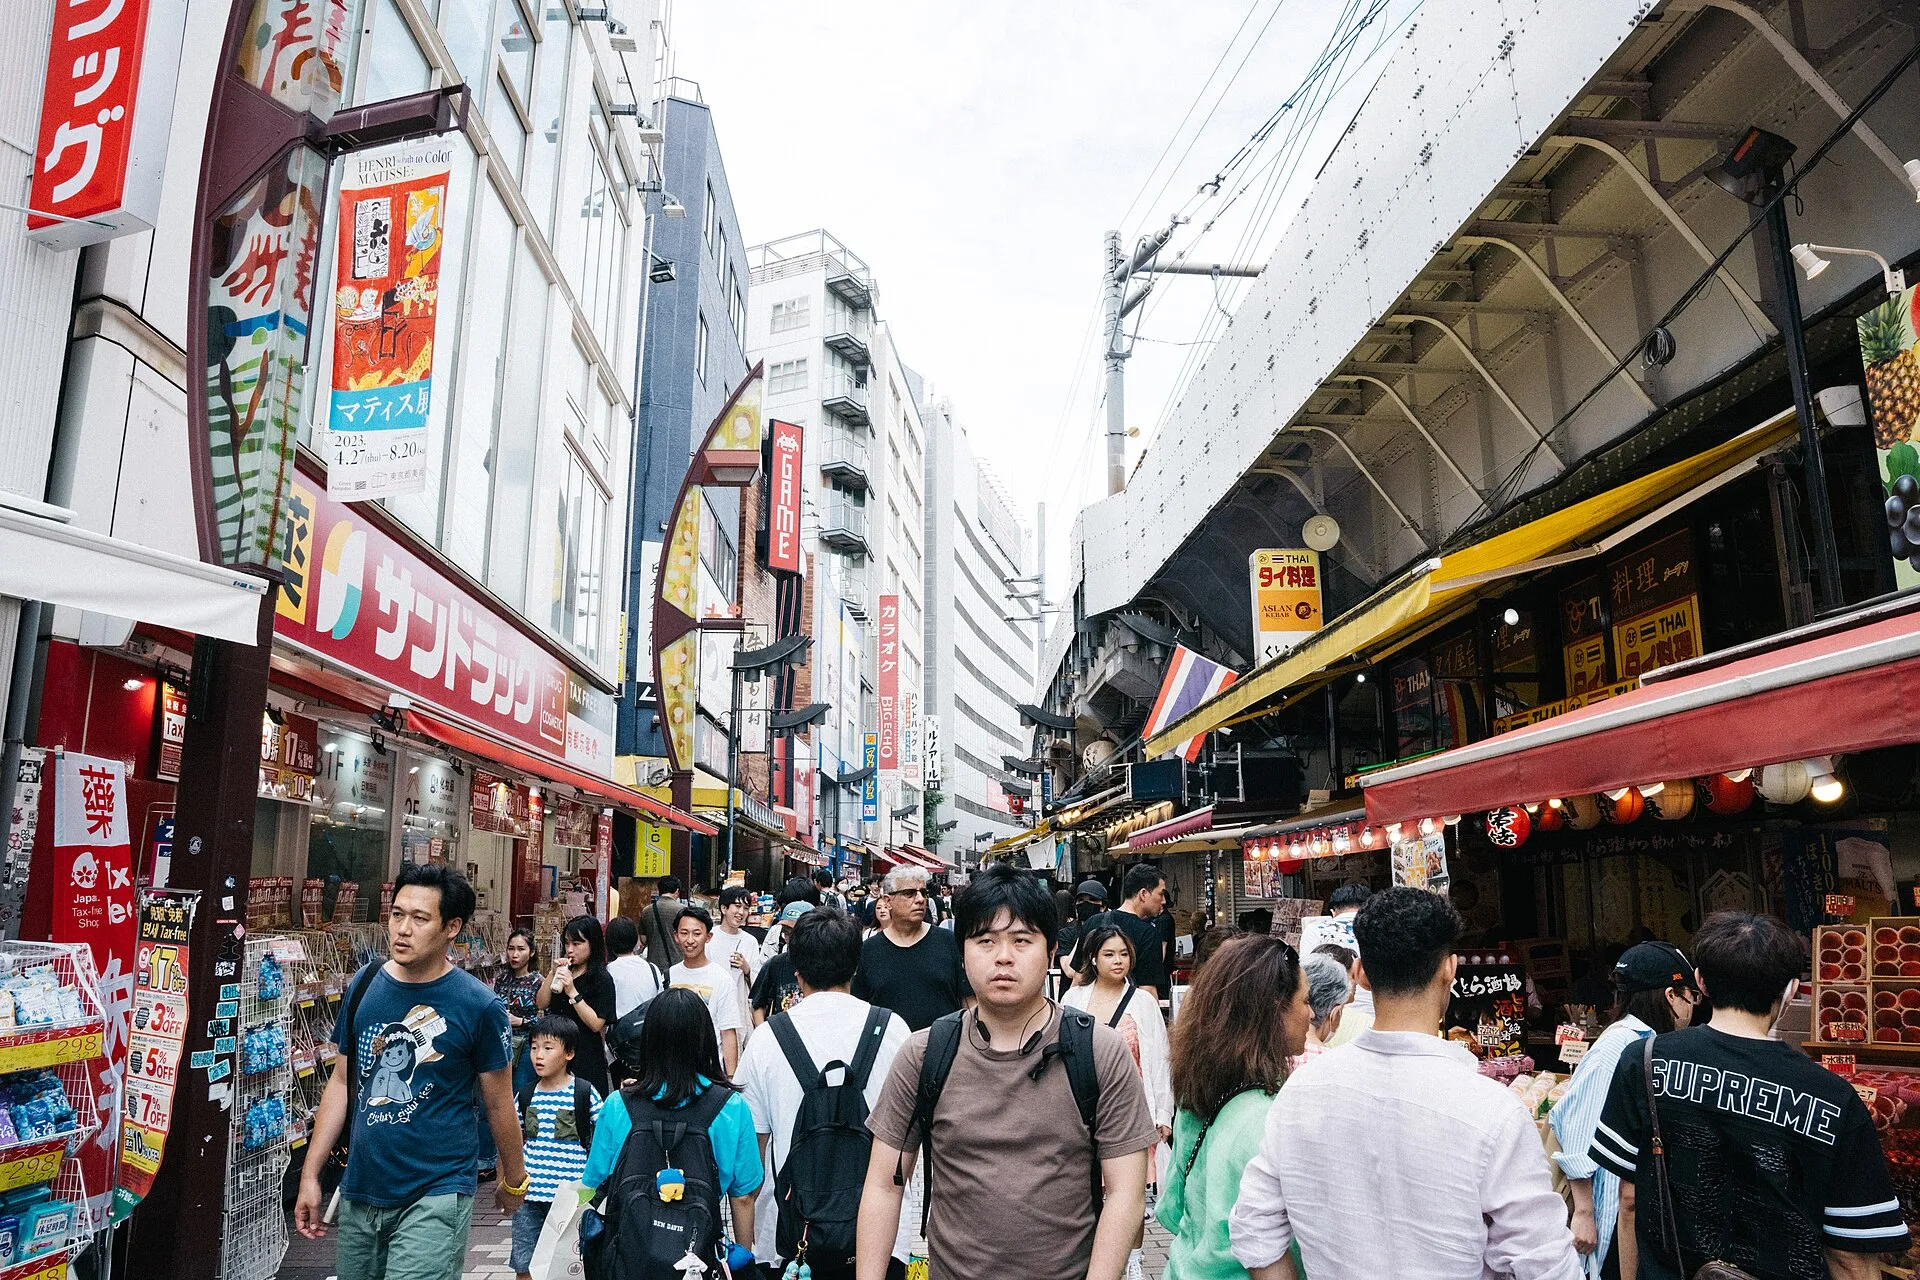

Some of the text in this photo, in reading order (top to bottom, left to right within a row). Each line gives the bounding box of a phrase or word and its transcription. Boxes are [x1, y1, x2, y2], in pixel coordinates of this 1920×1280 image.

[358, 155, 397, 173] HENRI
[424, 149, 453, 164] Color
[334, 434, 366, 447] 2023.
[776, 454, 795, 559] GAME
[1286, 554, 1309, 563] THAI
[1259, 565, 1317, 588] タイ料理
[1612, 557, 1660, 604] 料理
[1262, 604, 1293, 612] ASLAN
[1658, 610, 1687, 635] THAI
[880, 604, 898, 674] カラオケ
[569, 680, 582, 705] TAX
[551, 696, 556, 709] &
[166, 717, 184, 737] Tax
[284, 731, 299, 766] 17
[928, 730, 938, 779] ルノアール
[929, 781, 938, 789] B1
[73, 893, 101, 904] Japa
[161, 924, 187, 942] Tax-free
[171, 978, 187, 993] OFF
[162, 1020, 183, 1036] OFF
[56, 1035, 97, 1057] 298
[156, 1066, 175, 1082] OFF
[1651, 1058, 1841, 1146] SUPREME
[149, 1107, 168, 1128] OFF
[367, 1109, 400, 1127] Eighty
[36, 1220, 68, 1236] 休足時間
[653, 1219, 684, 1232] BEN DAVIS
